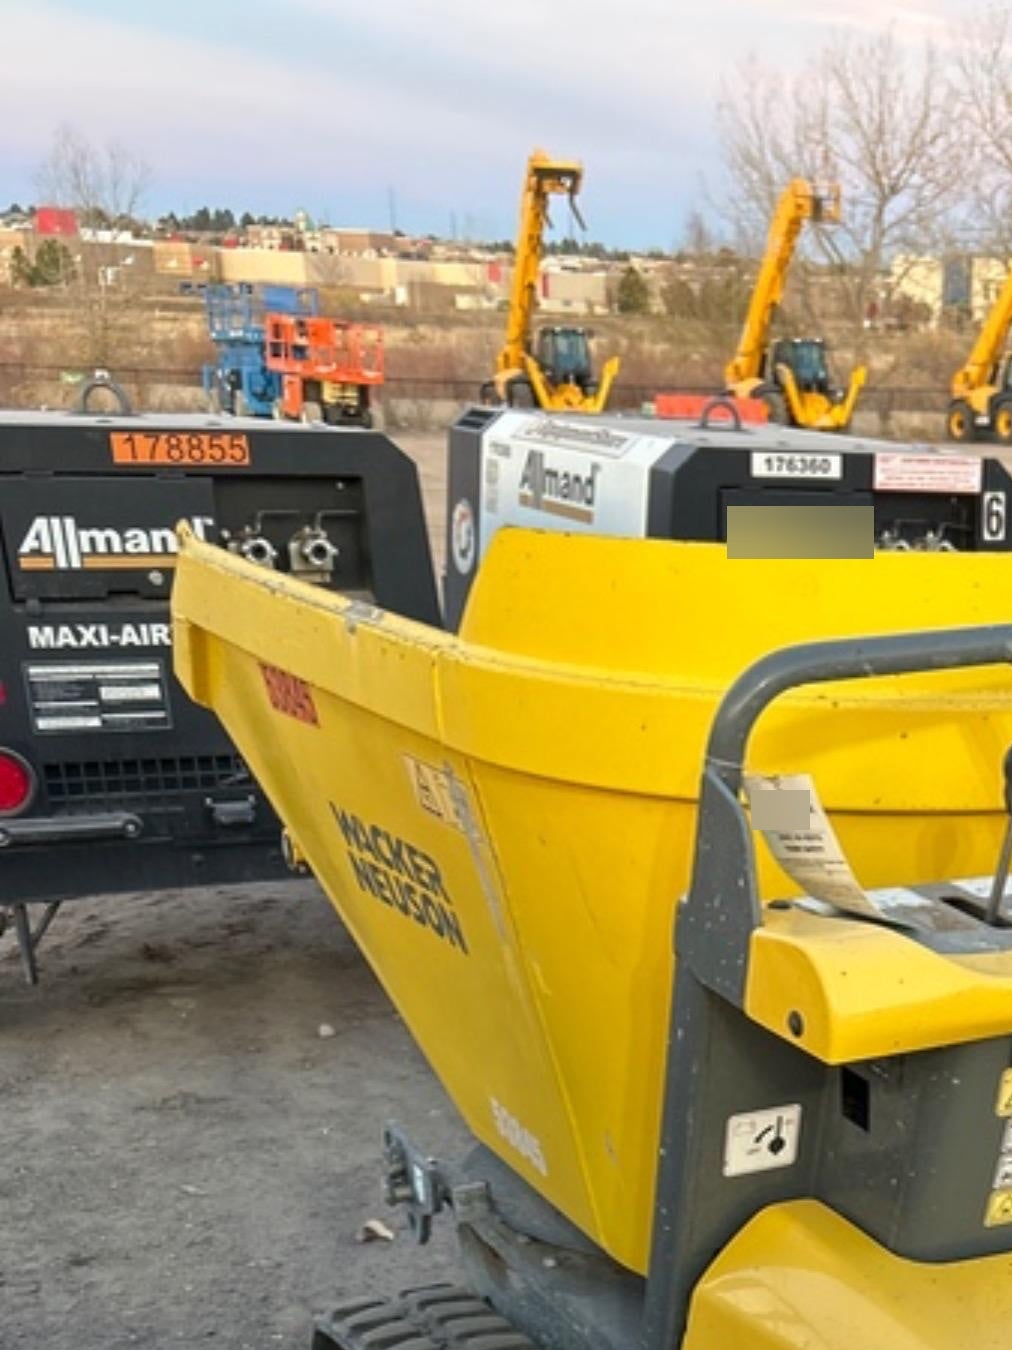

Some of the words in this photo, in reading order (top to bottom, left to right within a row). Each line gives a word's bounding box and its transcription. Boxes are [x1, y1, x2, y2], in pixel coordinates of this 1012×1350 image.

[123, 433, 247, 462] 178855
[763, 457, 831, 474] 176360
[520, 449, 600, 508] Allmand
[986, 496, 1005, 537] 6
[28, 623, 172, 648] MAXI-AIR
[328, 801, 453, 908] WACKER
[348, 850, 470, 956] NEUSON
